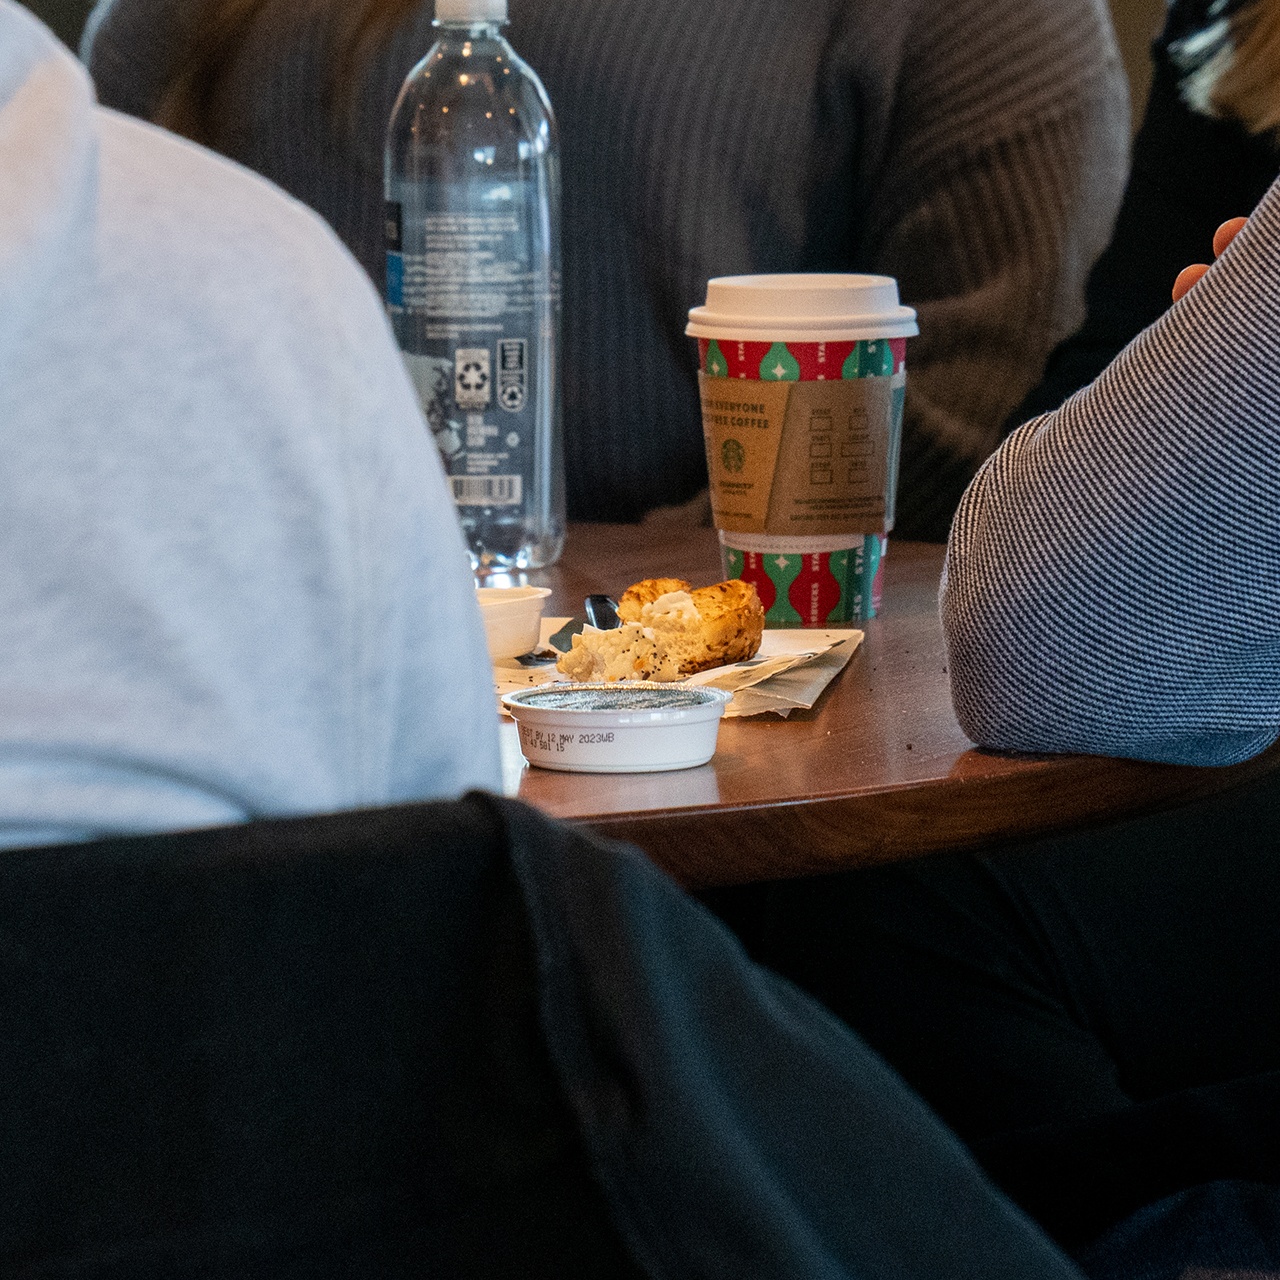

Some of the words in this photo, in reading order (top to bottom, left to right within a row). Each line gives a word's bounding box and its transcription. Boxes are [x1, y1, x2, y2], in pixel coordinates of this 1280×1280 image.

[730, 416, 770, 429] COFFEE
[535, 730, 544, 741] BY
[547, 733, 556, 743] 12
[559, 734, 574, 744] MAY
[579, 732, 615, 744] 2023WB
[556, 743, 565, 752] 15
